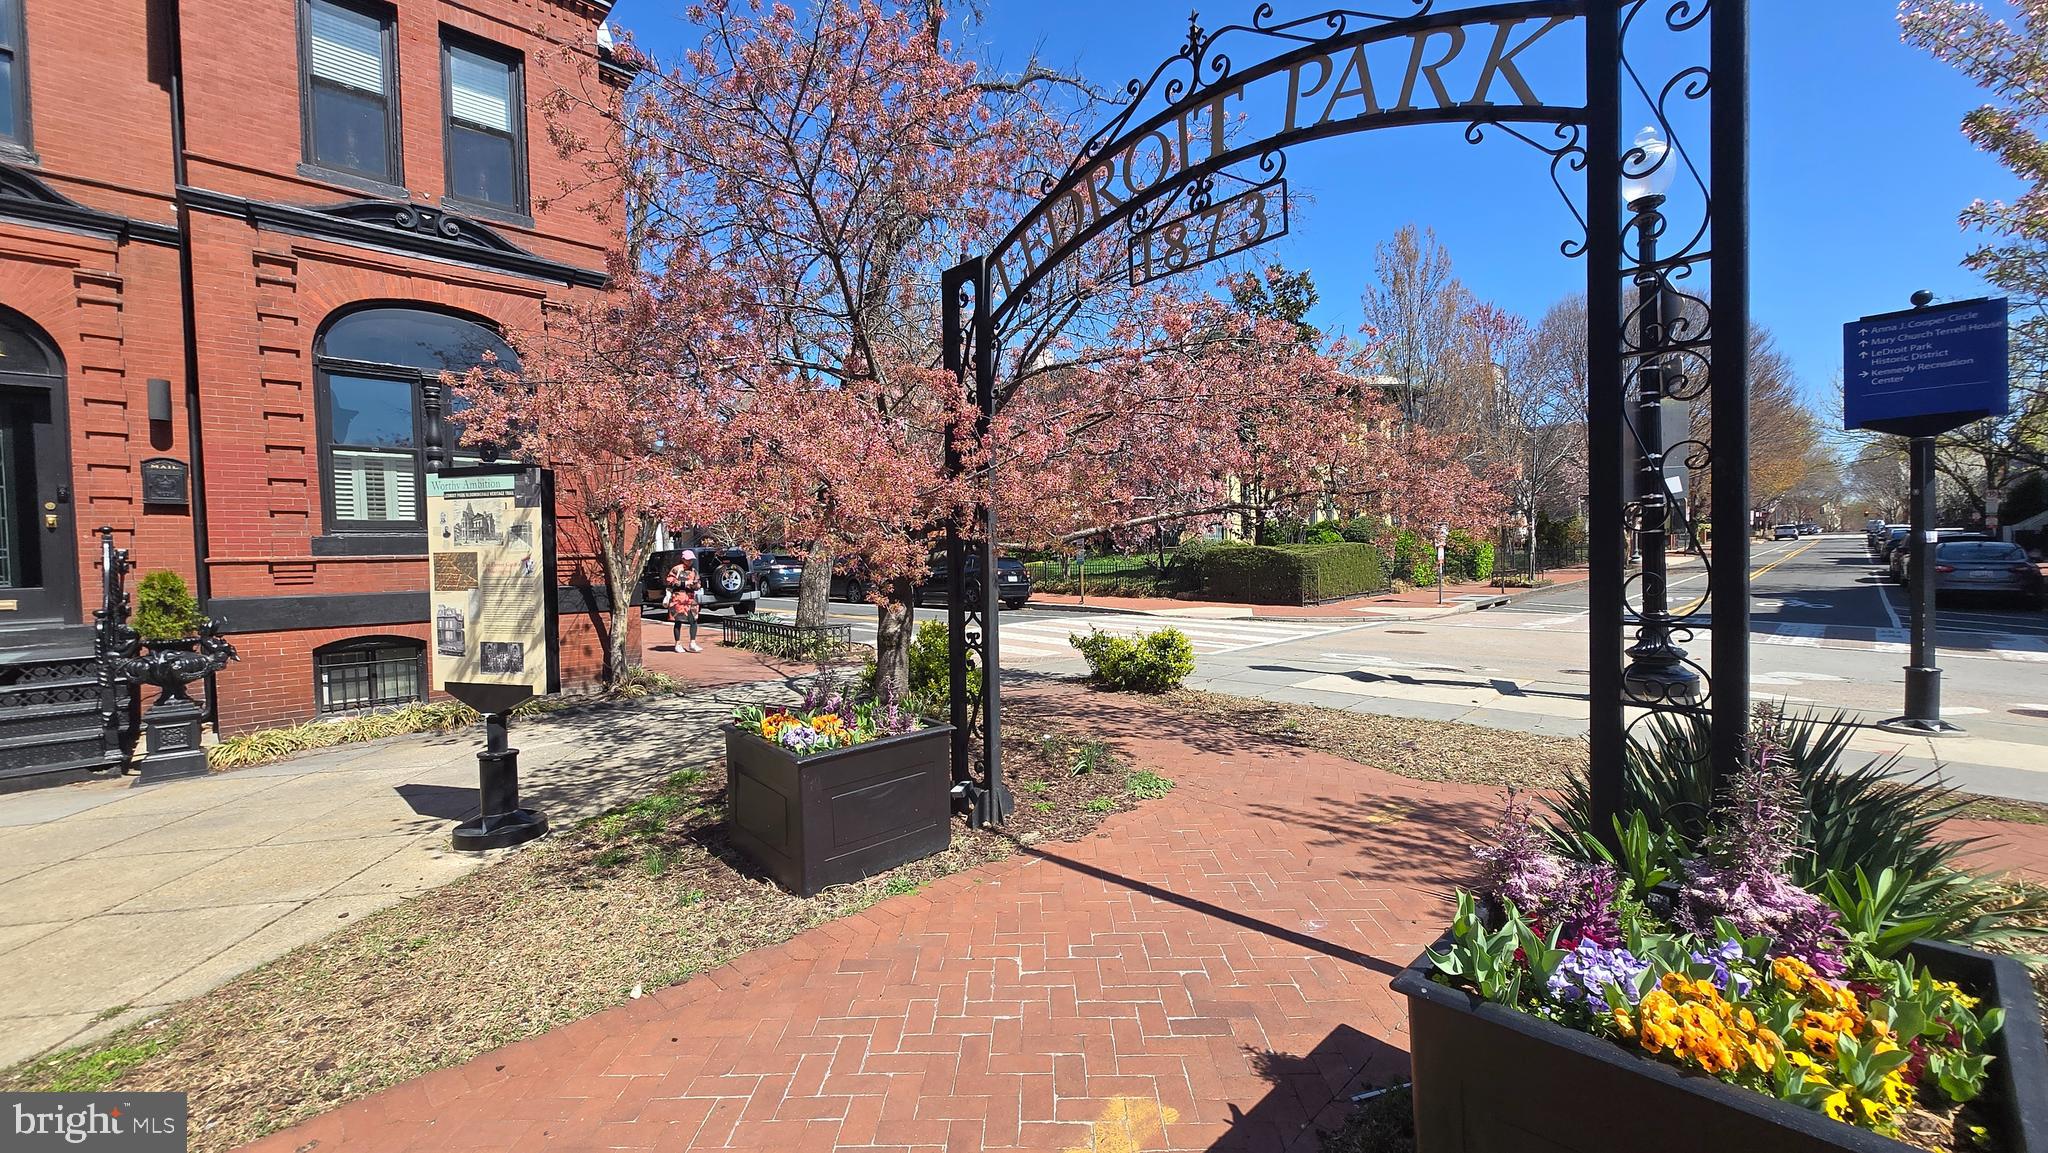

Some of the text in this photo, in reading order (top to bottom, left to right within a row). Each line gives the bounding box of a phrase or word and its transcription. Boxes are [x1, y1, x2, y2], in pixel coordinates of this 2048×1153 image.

[1276, 14, 1575, 136] PARK
[1139, 190, 1269, 281] 1873
[1871, 325, 1897, 334] Anna
[1908, 317, 1947, 328] Cooper
[1948, 311, 1979, 322] Circle
[1871, 320, 2003, 346] Mary Church Terrell House
[1871, 342, 1933, 357] LeDroit Park
[1871, 349, 1949, 365] Historic District
[1871, 358, 1974, 376] Kennedy Recreation
[1871, 375, 1905, 385] Center
[431, 478, 501, 492] Worthy Ambition
